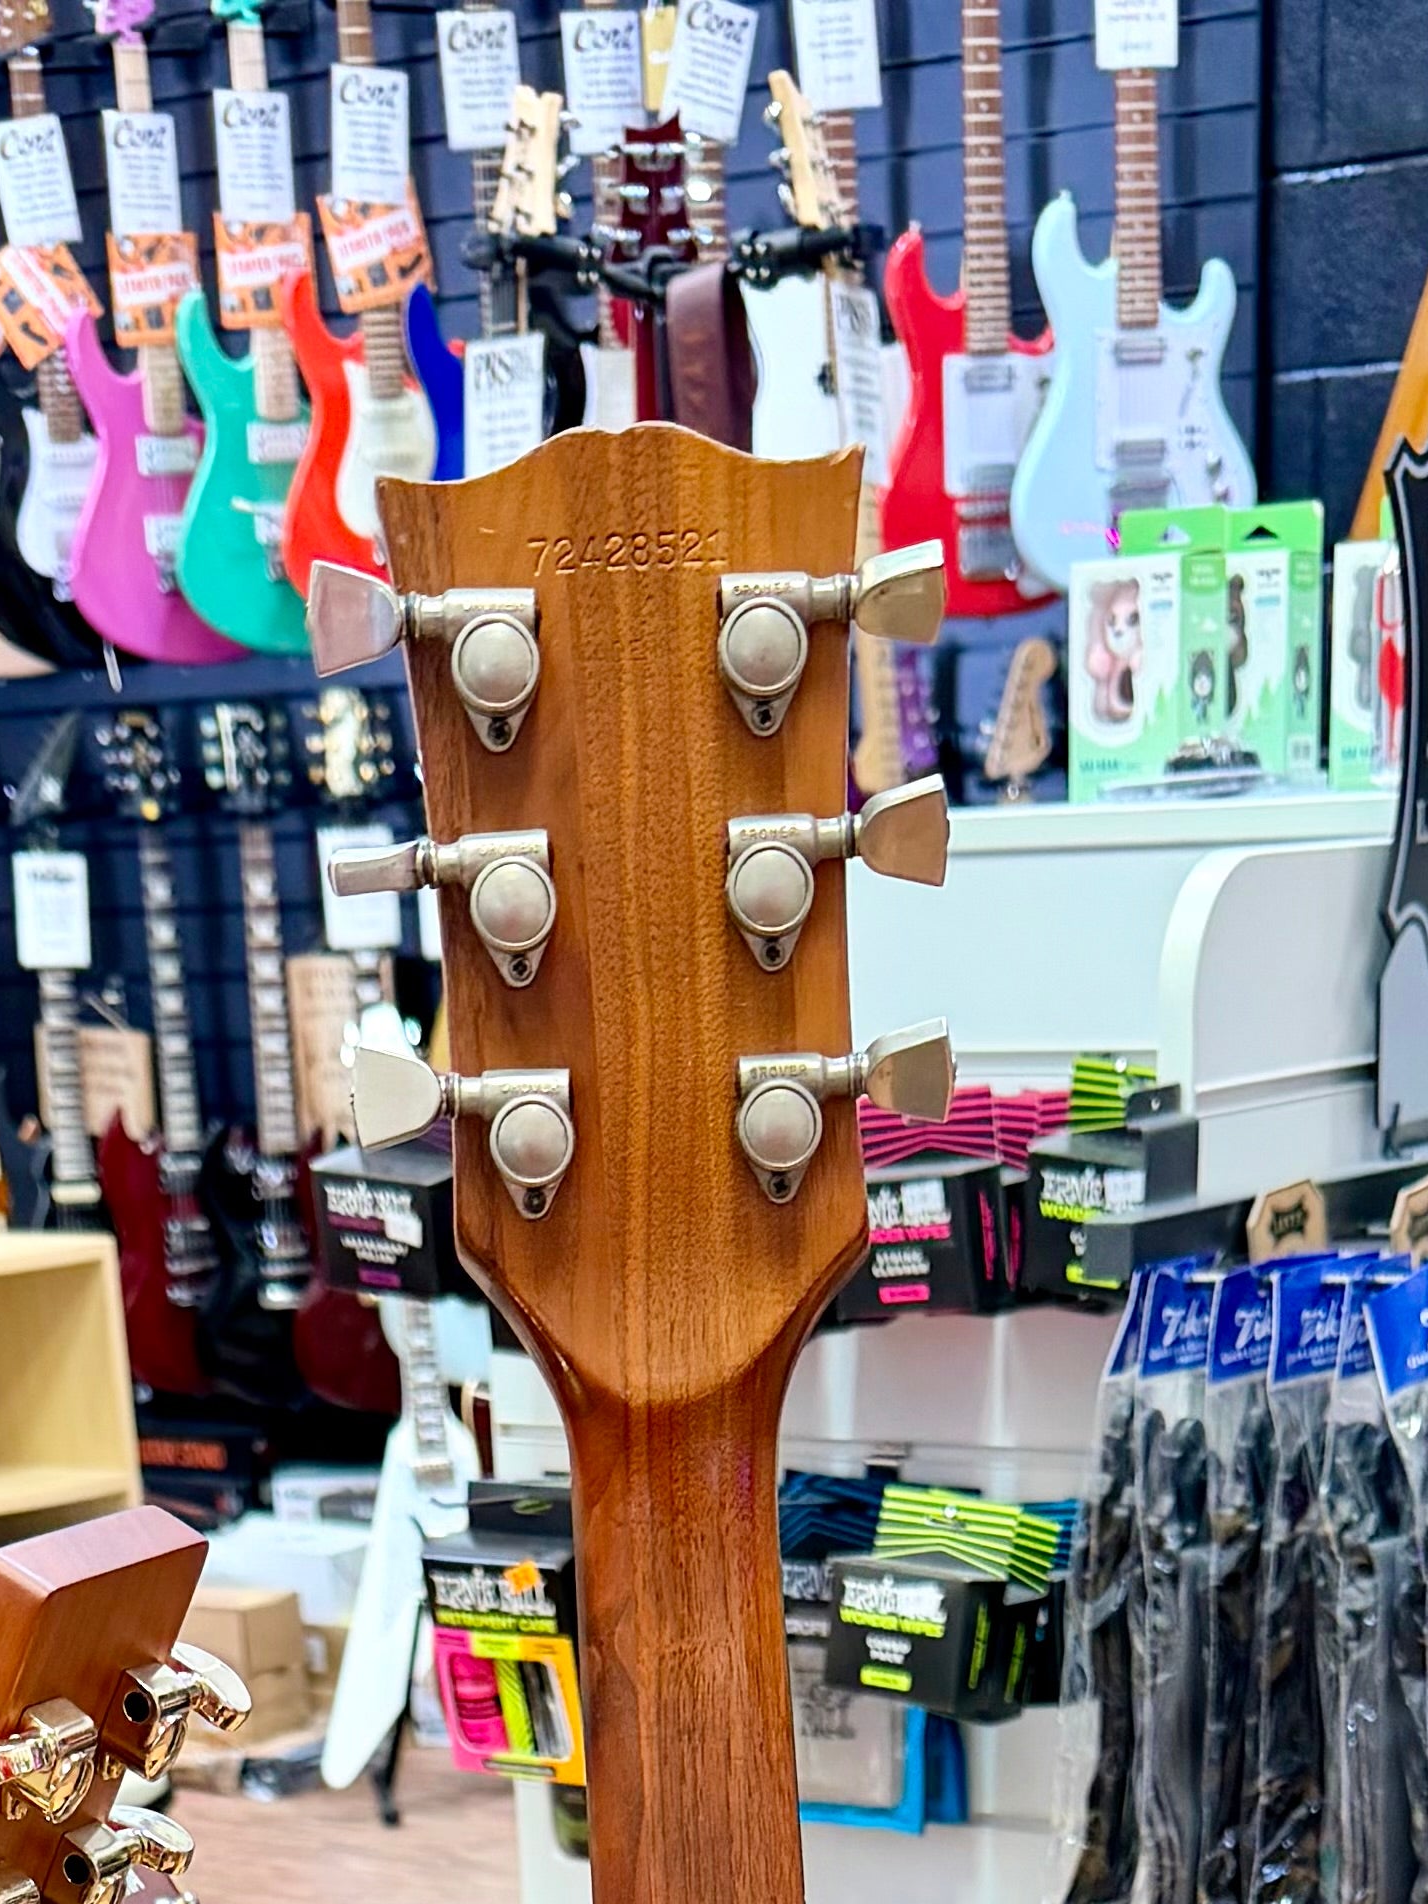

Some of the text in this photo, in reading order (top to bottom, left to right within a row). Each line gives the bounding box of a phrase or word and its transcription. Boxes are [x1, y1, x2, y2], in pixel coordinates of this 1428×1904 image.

[448, 20, 507, 54] Cort
[573, 20, 634, 53] Cort
[340, 73, 400, 107] Cort
[223, 99, 280, 130] Cort
[0, 129, 56, 161] Cort
[113, 118, 167, 149] Cort
[527, 527, 727, 578] 72428521
[739, 826, 801, 842] GROVER
[749, 1063, 808, 1082] GROVER
[430, 1565, 501, 1613] ERNIE
[842, 1574, 900, 1611] ERNIE
[435, 1610, 558, 1634] INSTRUMENT CARE
[840, 1606, 899, 1630] WONDER
[900, 1618, 946, 1639] WIPES
